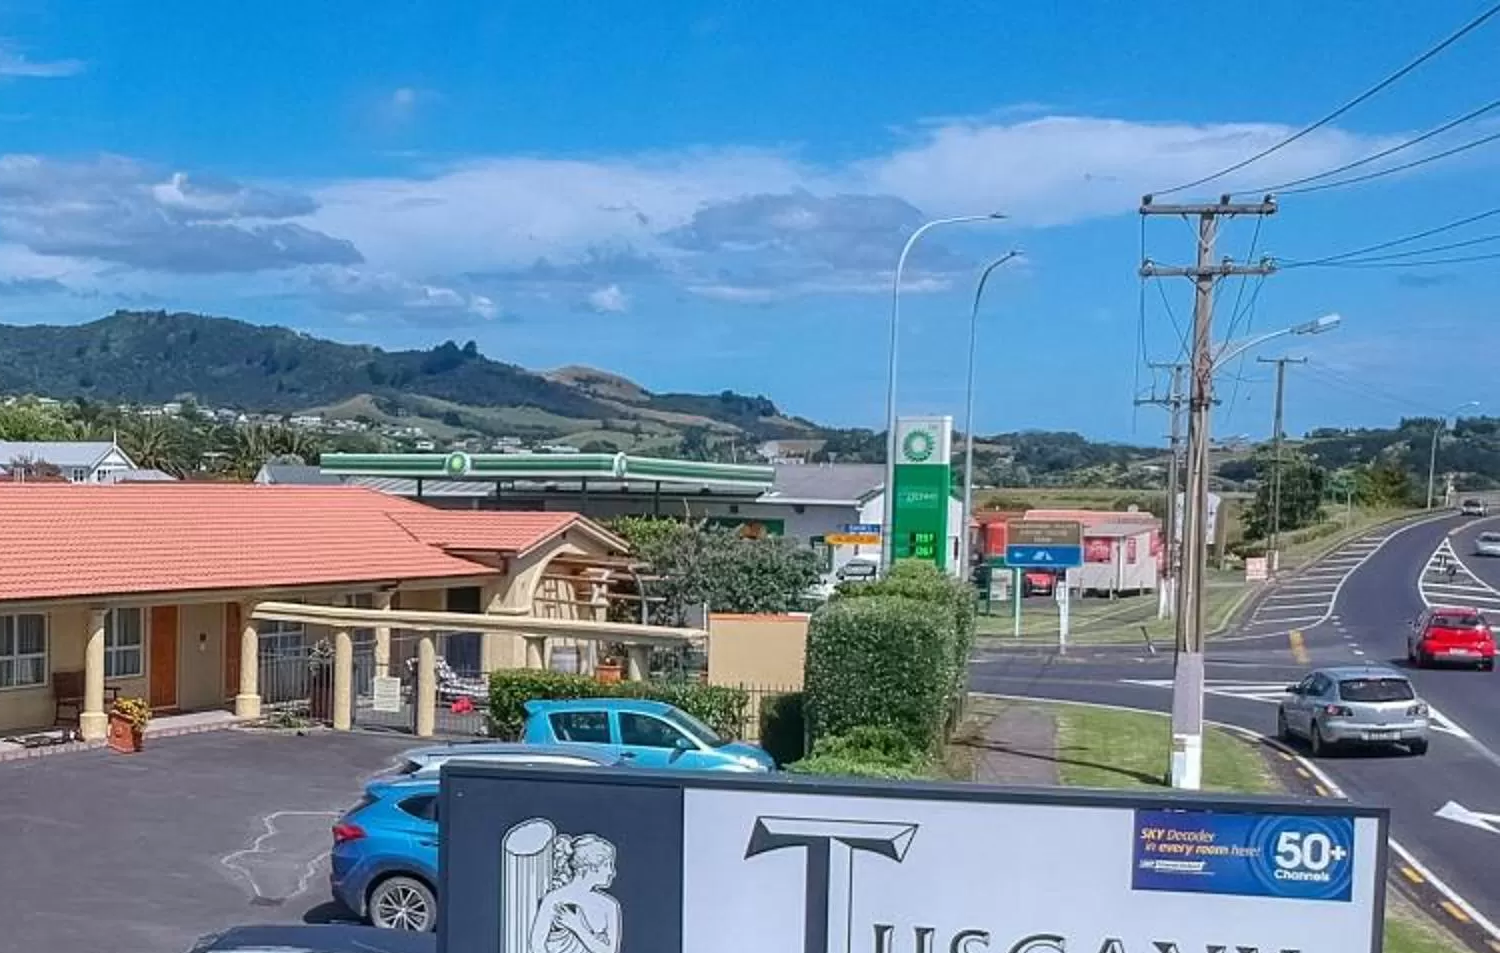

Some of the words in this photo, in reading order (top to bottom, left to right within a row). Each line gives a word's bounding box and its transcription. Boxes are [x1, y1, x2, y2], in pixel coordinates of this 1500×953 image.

[1140, 827, 1165, 840] SKY
[1167, 829, 1216, 843] Decoder
[1145, 842, 1156, 851] in
[1158, 843, 1194, 856] every
[1195, 845, 1229, 856] room
[1275, 831, 1347, 870] 50+
[1274, 869, 1330, 882] Channels
